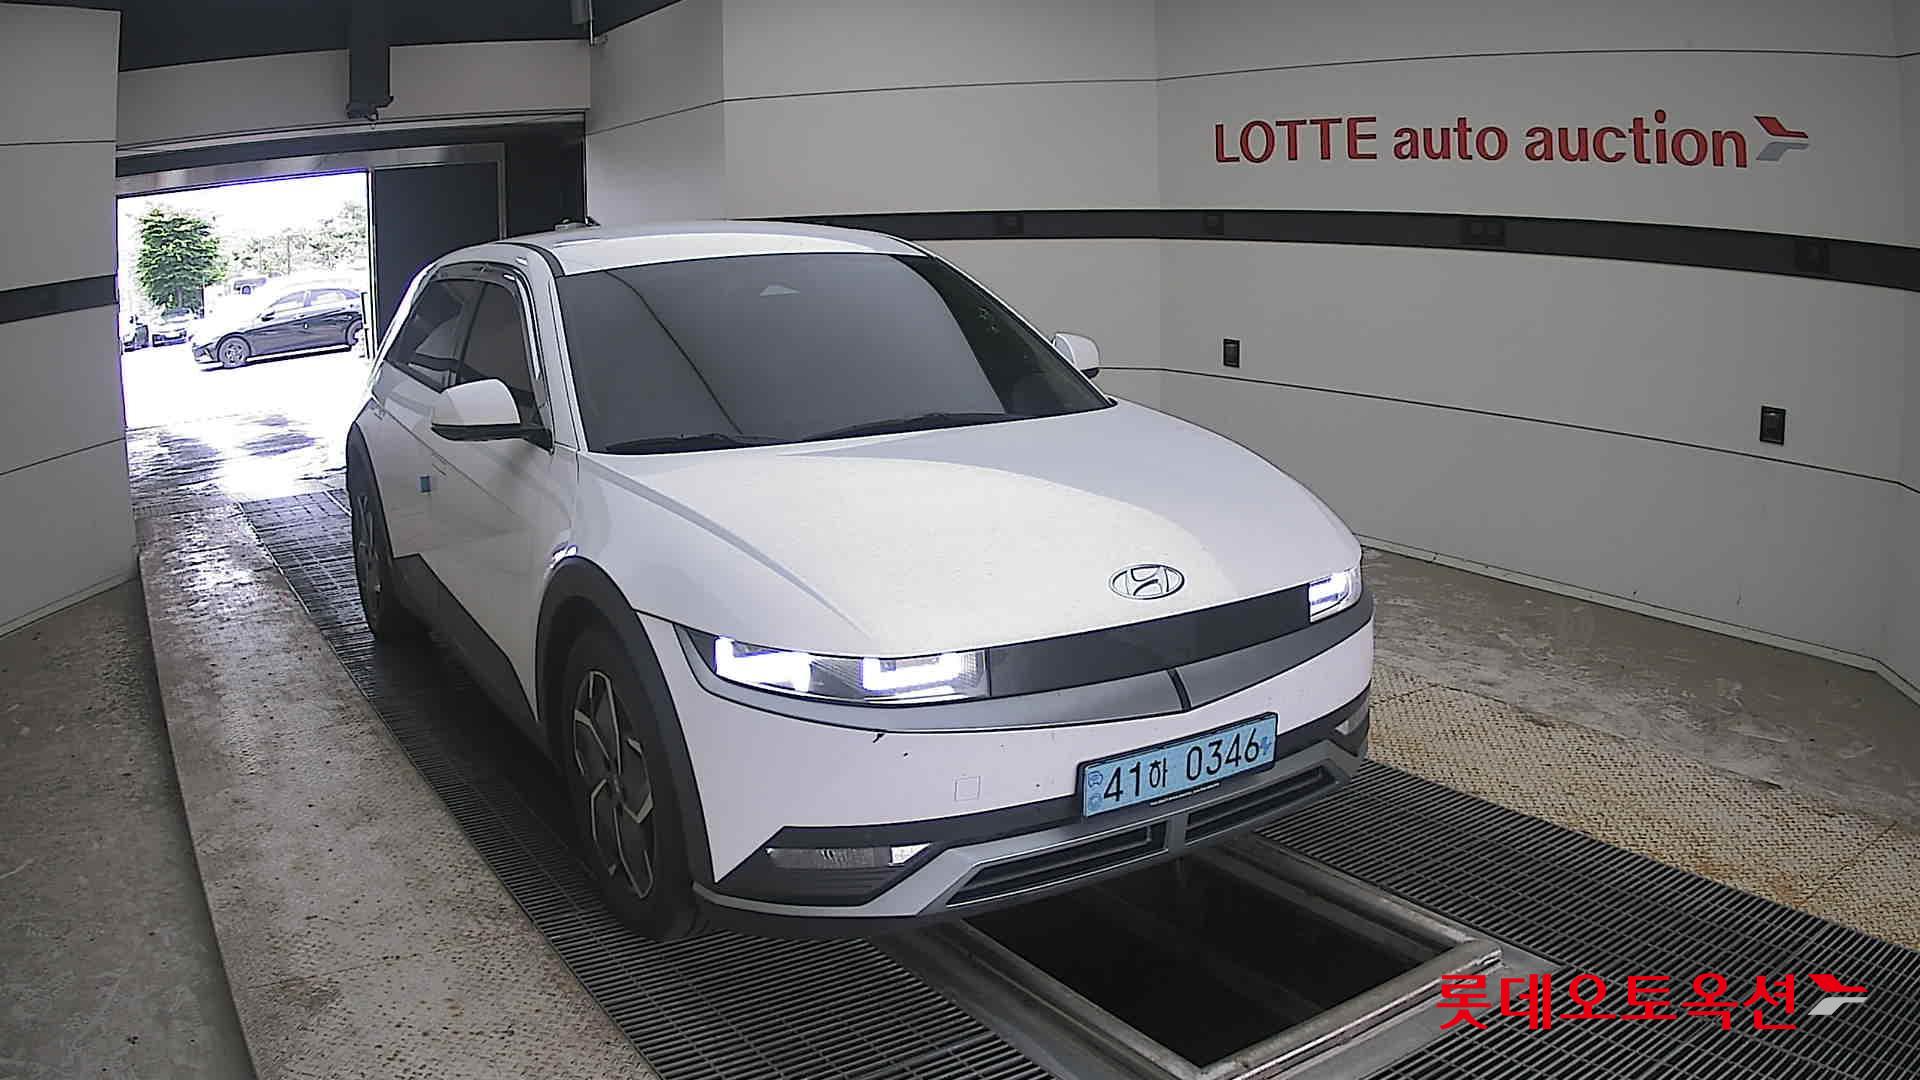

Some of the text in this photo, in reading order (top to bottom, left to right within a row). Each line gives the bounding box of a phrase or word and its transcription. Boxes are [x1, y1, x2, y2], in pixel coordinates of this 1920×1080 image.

[1214, 110, 1748, 168] LOTTE auto auction
[1103, 728, 1260, 802] 41하 0346
